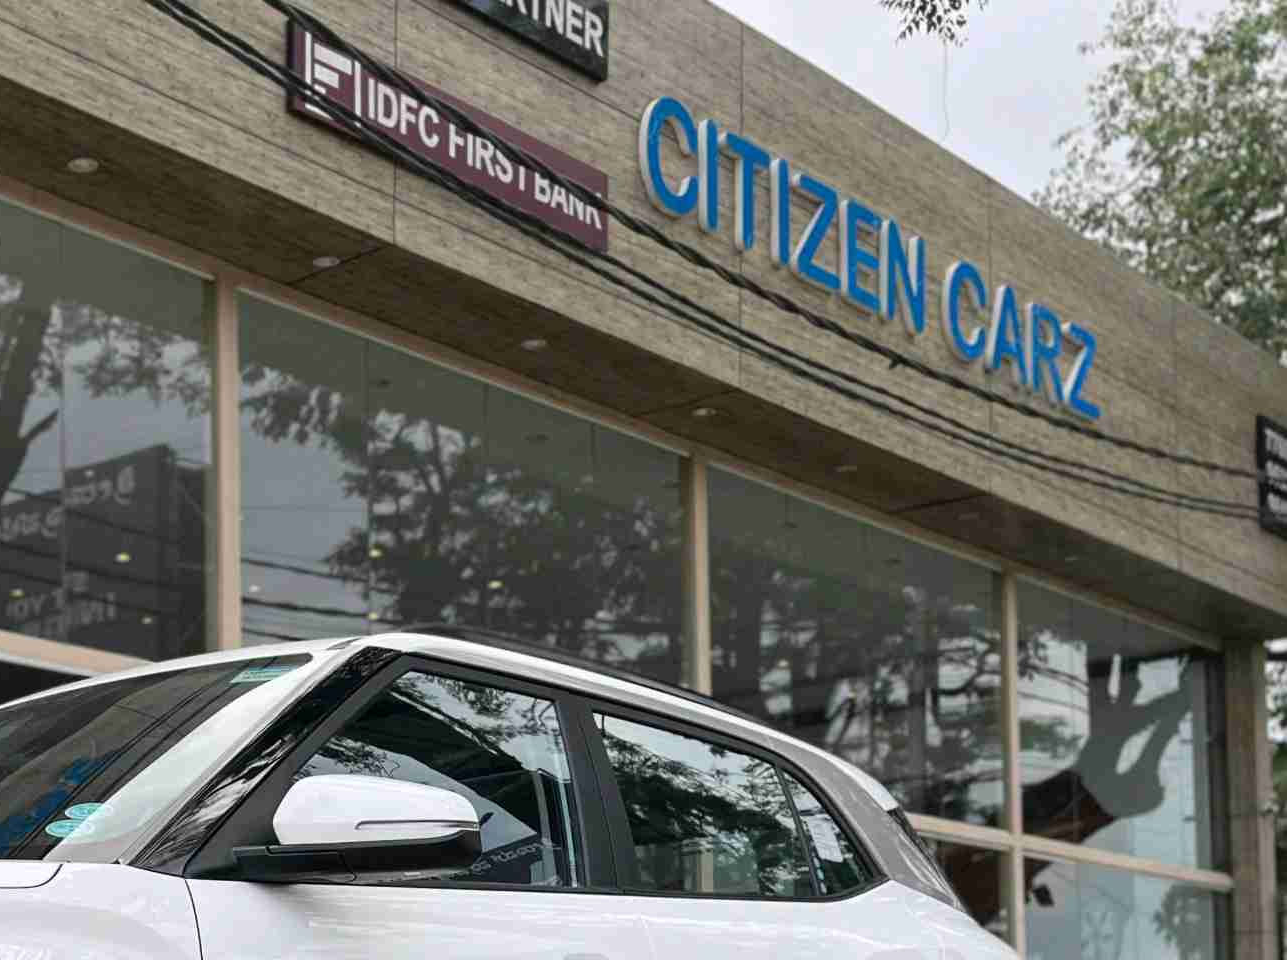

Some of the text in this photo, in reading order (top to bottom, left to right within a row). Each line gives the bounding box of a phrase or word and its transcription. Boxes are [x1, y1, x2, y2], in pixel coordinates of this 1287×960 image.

[368, 78, 440, 148] IDFC
[448, 122, 526, 191] FIRST
[639, 96, 1102, 420] CITIZEN CARZ
